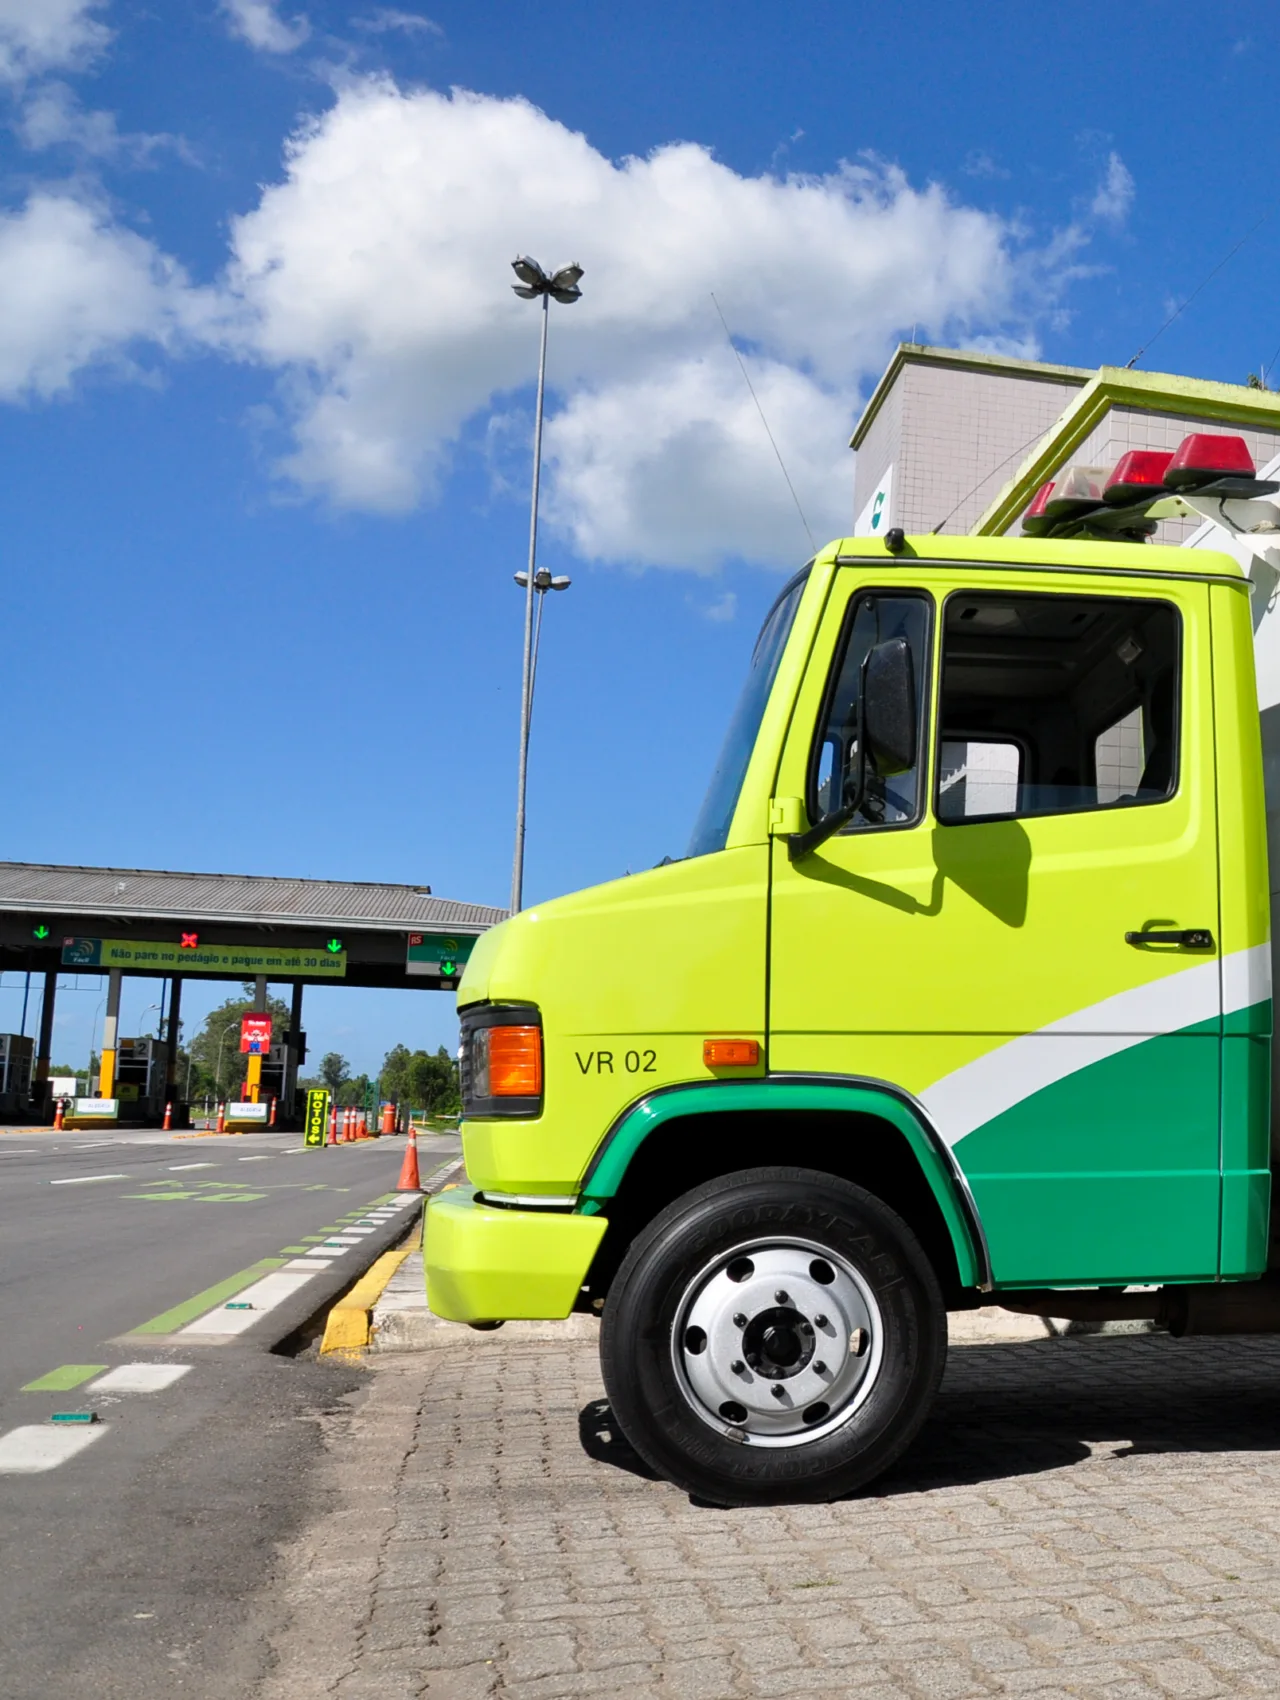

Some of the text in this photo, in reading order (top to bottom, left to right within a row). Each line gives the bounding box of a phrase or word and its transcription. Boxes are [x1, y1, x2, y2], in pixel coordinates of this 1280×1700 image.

[411, 936, 422, 945] RS
[111, 948, 131, 958] Não
[135, 950, 158, 961] pare
[161, 953, 175, 961] no
[178, 952, 219, 965] pedágio
[232, 956, 263, 966] pague
[266, 957, 282, 966] em
[285, 957, 301, 967] até
[304, 957, 317, 967] 30
[320, 958, 341, 968] dias
[138, 1043, 147, 1055] 2
[275, 1048, 281, 1060] 1
[575, 1049, 657, 1075] VR 02
[311, 1093, 324, 1134] MOTOS
[117, 1192, 269, 1203] 40
